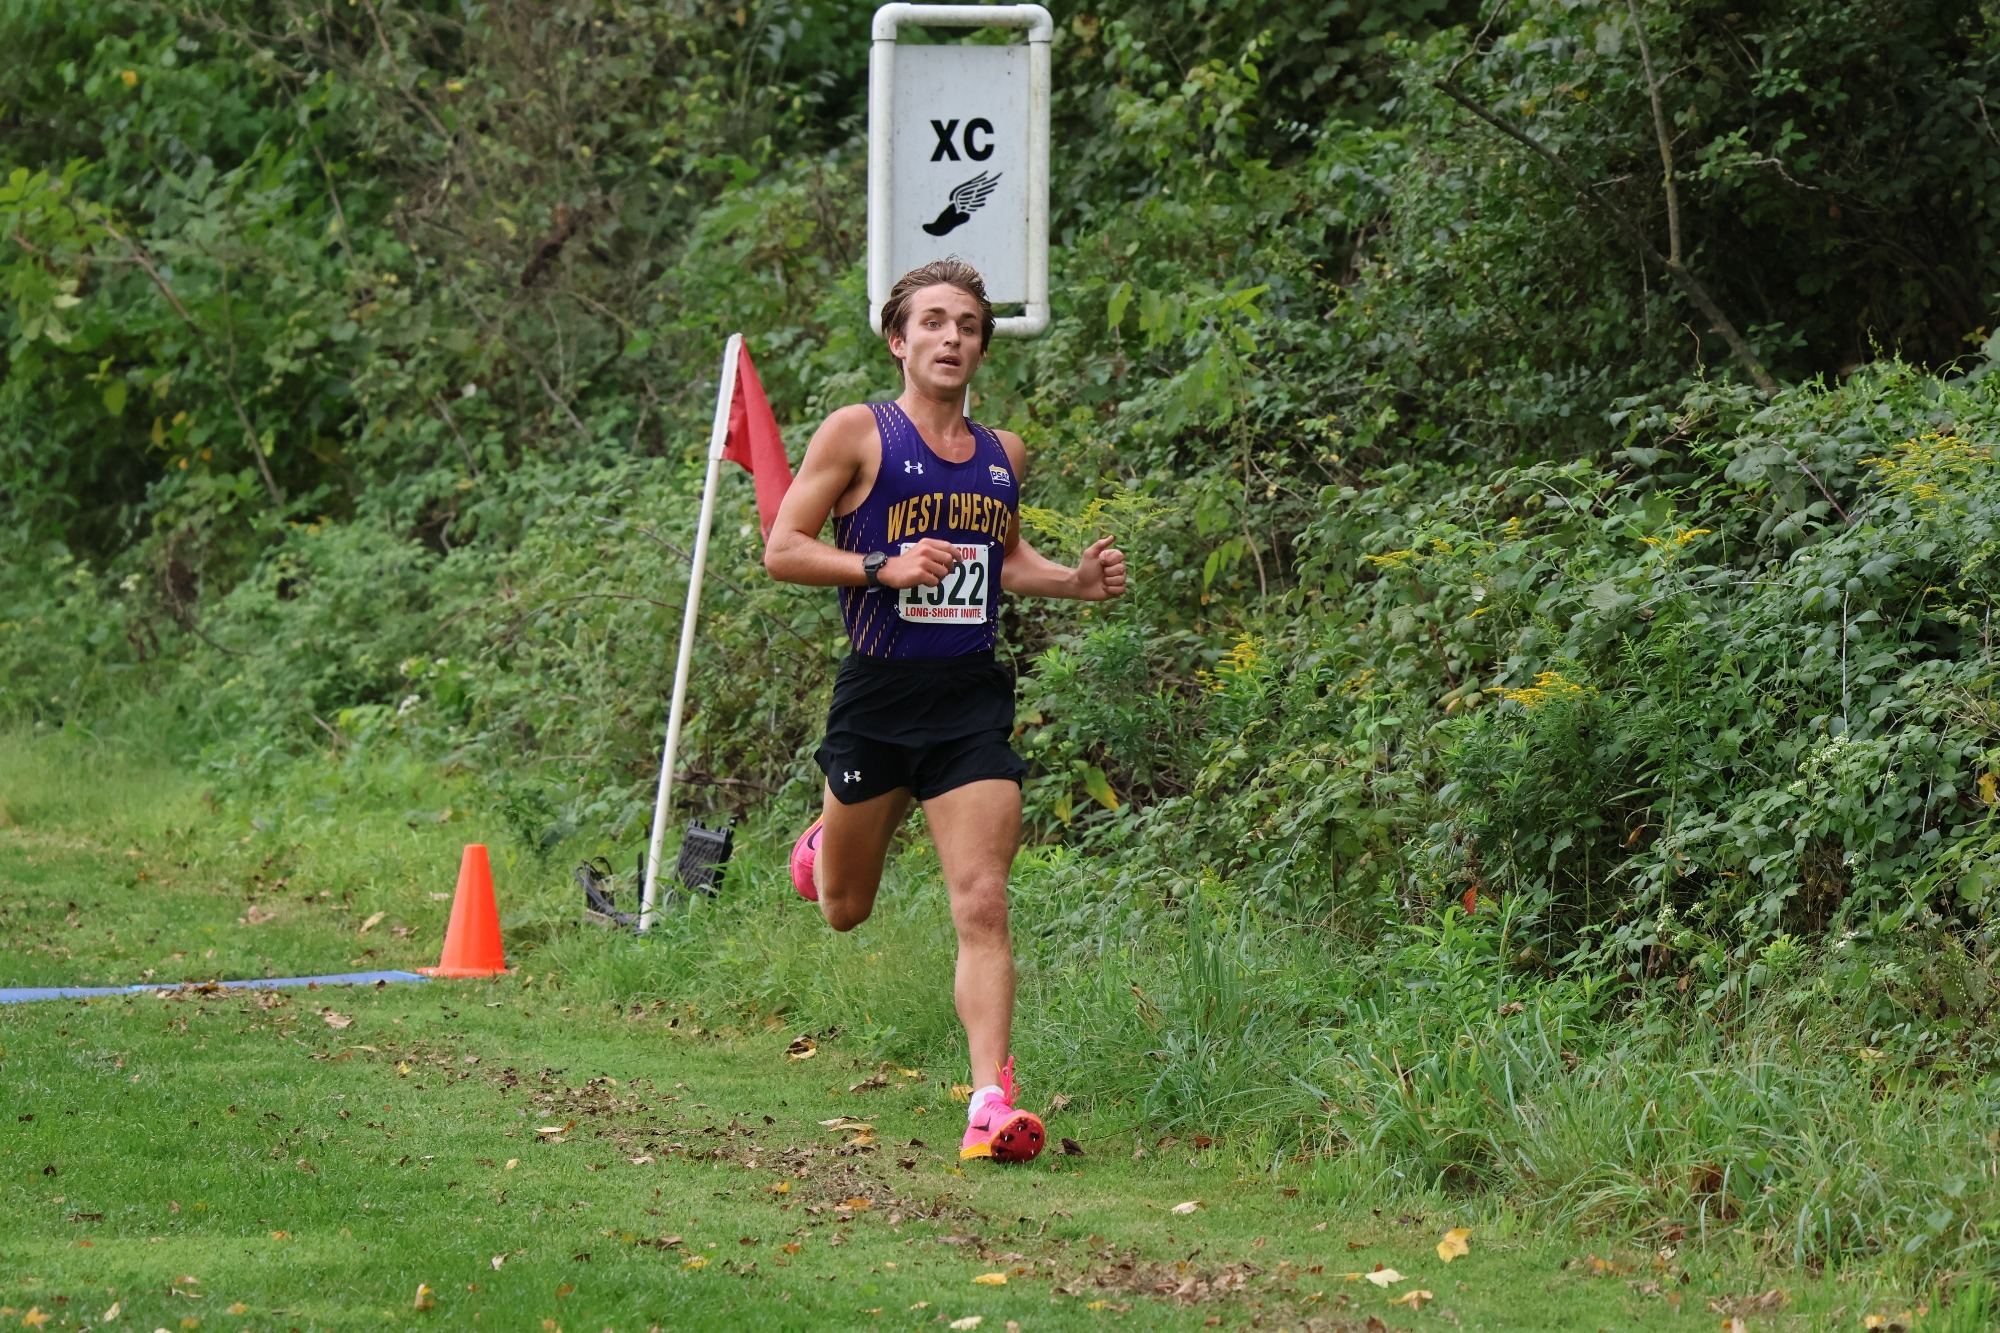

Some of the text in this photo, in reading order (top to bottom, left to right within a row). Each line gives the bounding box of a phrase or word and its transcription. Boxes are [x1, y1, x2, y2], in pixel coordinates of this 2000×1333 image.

[930, 117, 995, 162] XC
[887, 492, 943, 544] WEST
[905, 606, 982, 618] LONG-SHORT INVITE
